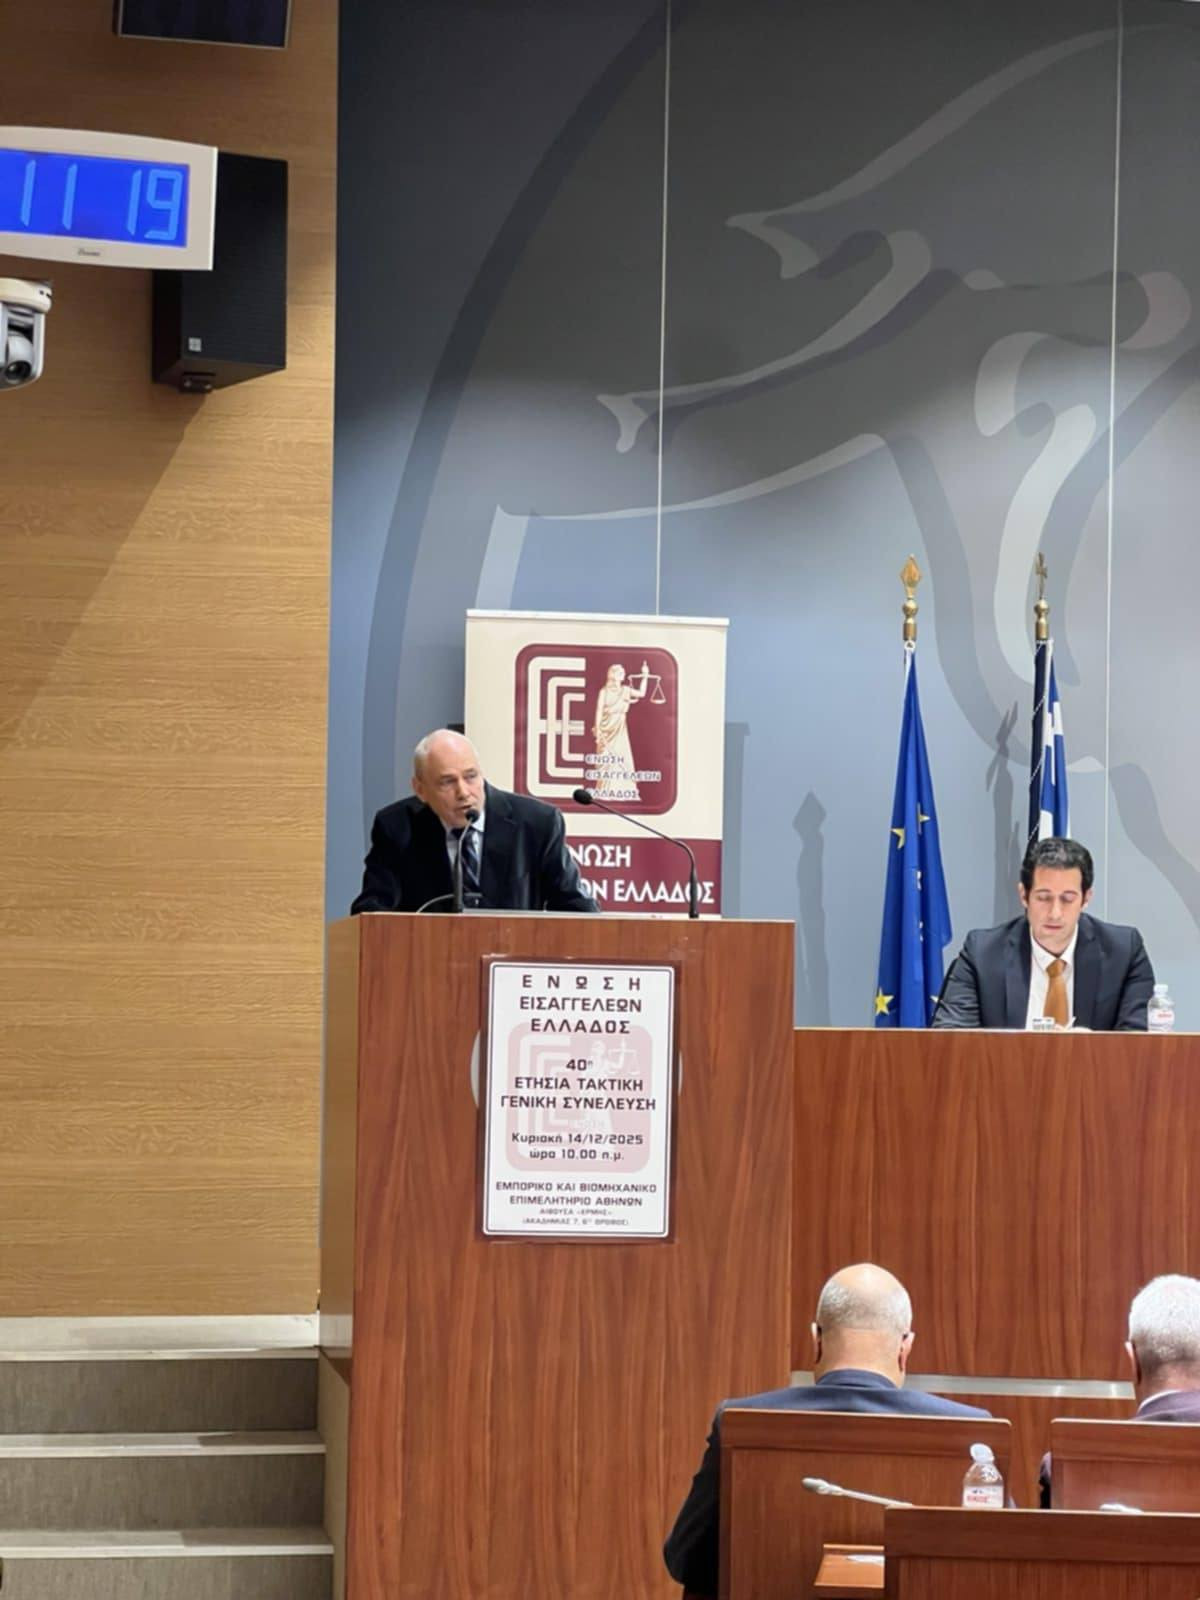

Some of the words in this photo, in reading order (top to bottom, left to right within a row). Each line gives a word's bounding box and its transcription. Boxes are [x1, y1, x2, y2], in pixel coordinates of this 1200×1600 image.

[586, 755, 624, 764] ΕΝΩΣΗ
[588, 789, 637, 799] ΛΛΑΔΟΣ
[567, 843, 632, 868] ΝΩΣΗ
[519, 996, 642, 1013] ΕΙΣΑΓΓΕΛΕΩΝ
[531, 1018, 631, 1035] ΕΛΛΑΔΟΣ
[514, 1076, 570, 1090] ΕΤΗΣΙΑ
[577, 1078, 643, 1091] ΤΑΚΤΙΚΗ
[500, 1096, 556, 1109] ΓΕΝΙΚΗ
[563, 1097, 656, 1111] ΣΥΝΕΛΕΥΣΗ
[568, 1134, 644, 1145] 14/12/2025
[561, 1149, 597, 1160] 10.00
[495, 1181, 553, 1191] ΕΜΠΟΡΙΚΟ
[556, 1183, 576, 1192] ΚΑΙ
[579, 1183, 657, 1193] ΒΙΟΜΗΧΑΝΙΚΟ
[509, 1195, 591, 1206] ΕΠΙΜΕΛΗΤΗΡΙΟ
[595, 1197, 642, 1206] ΑΘΗΝΩΝ
